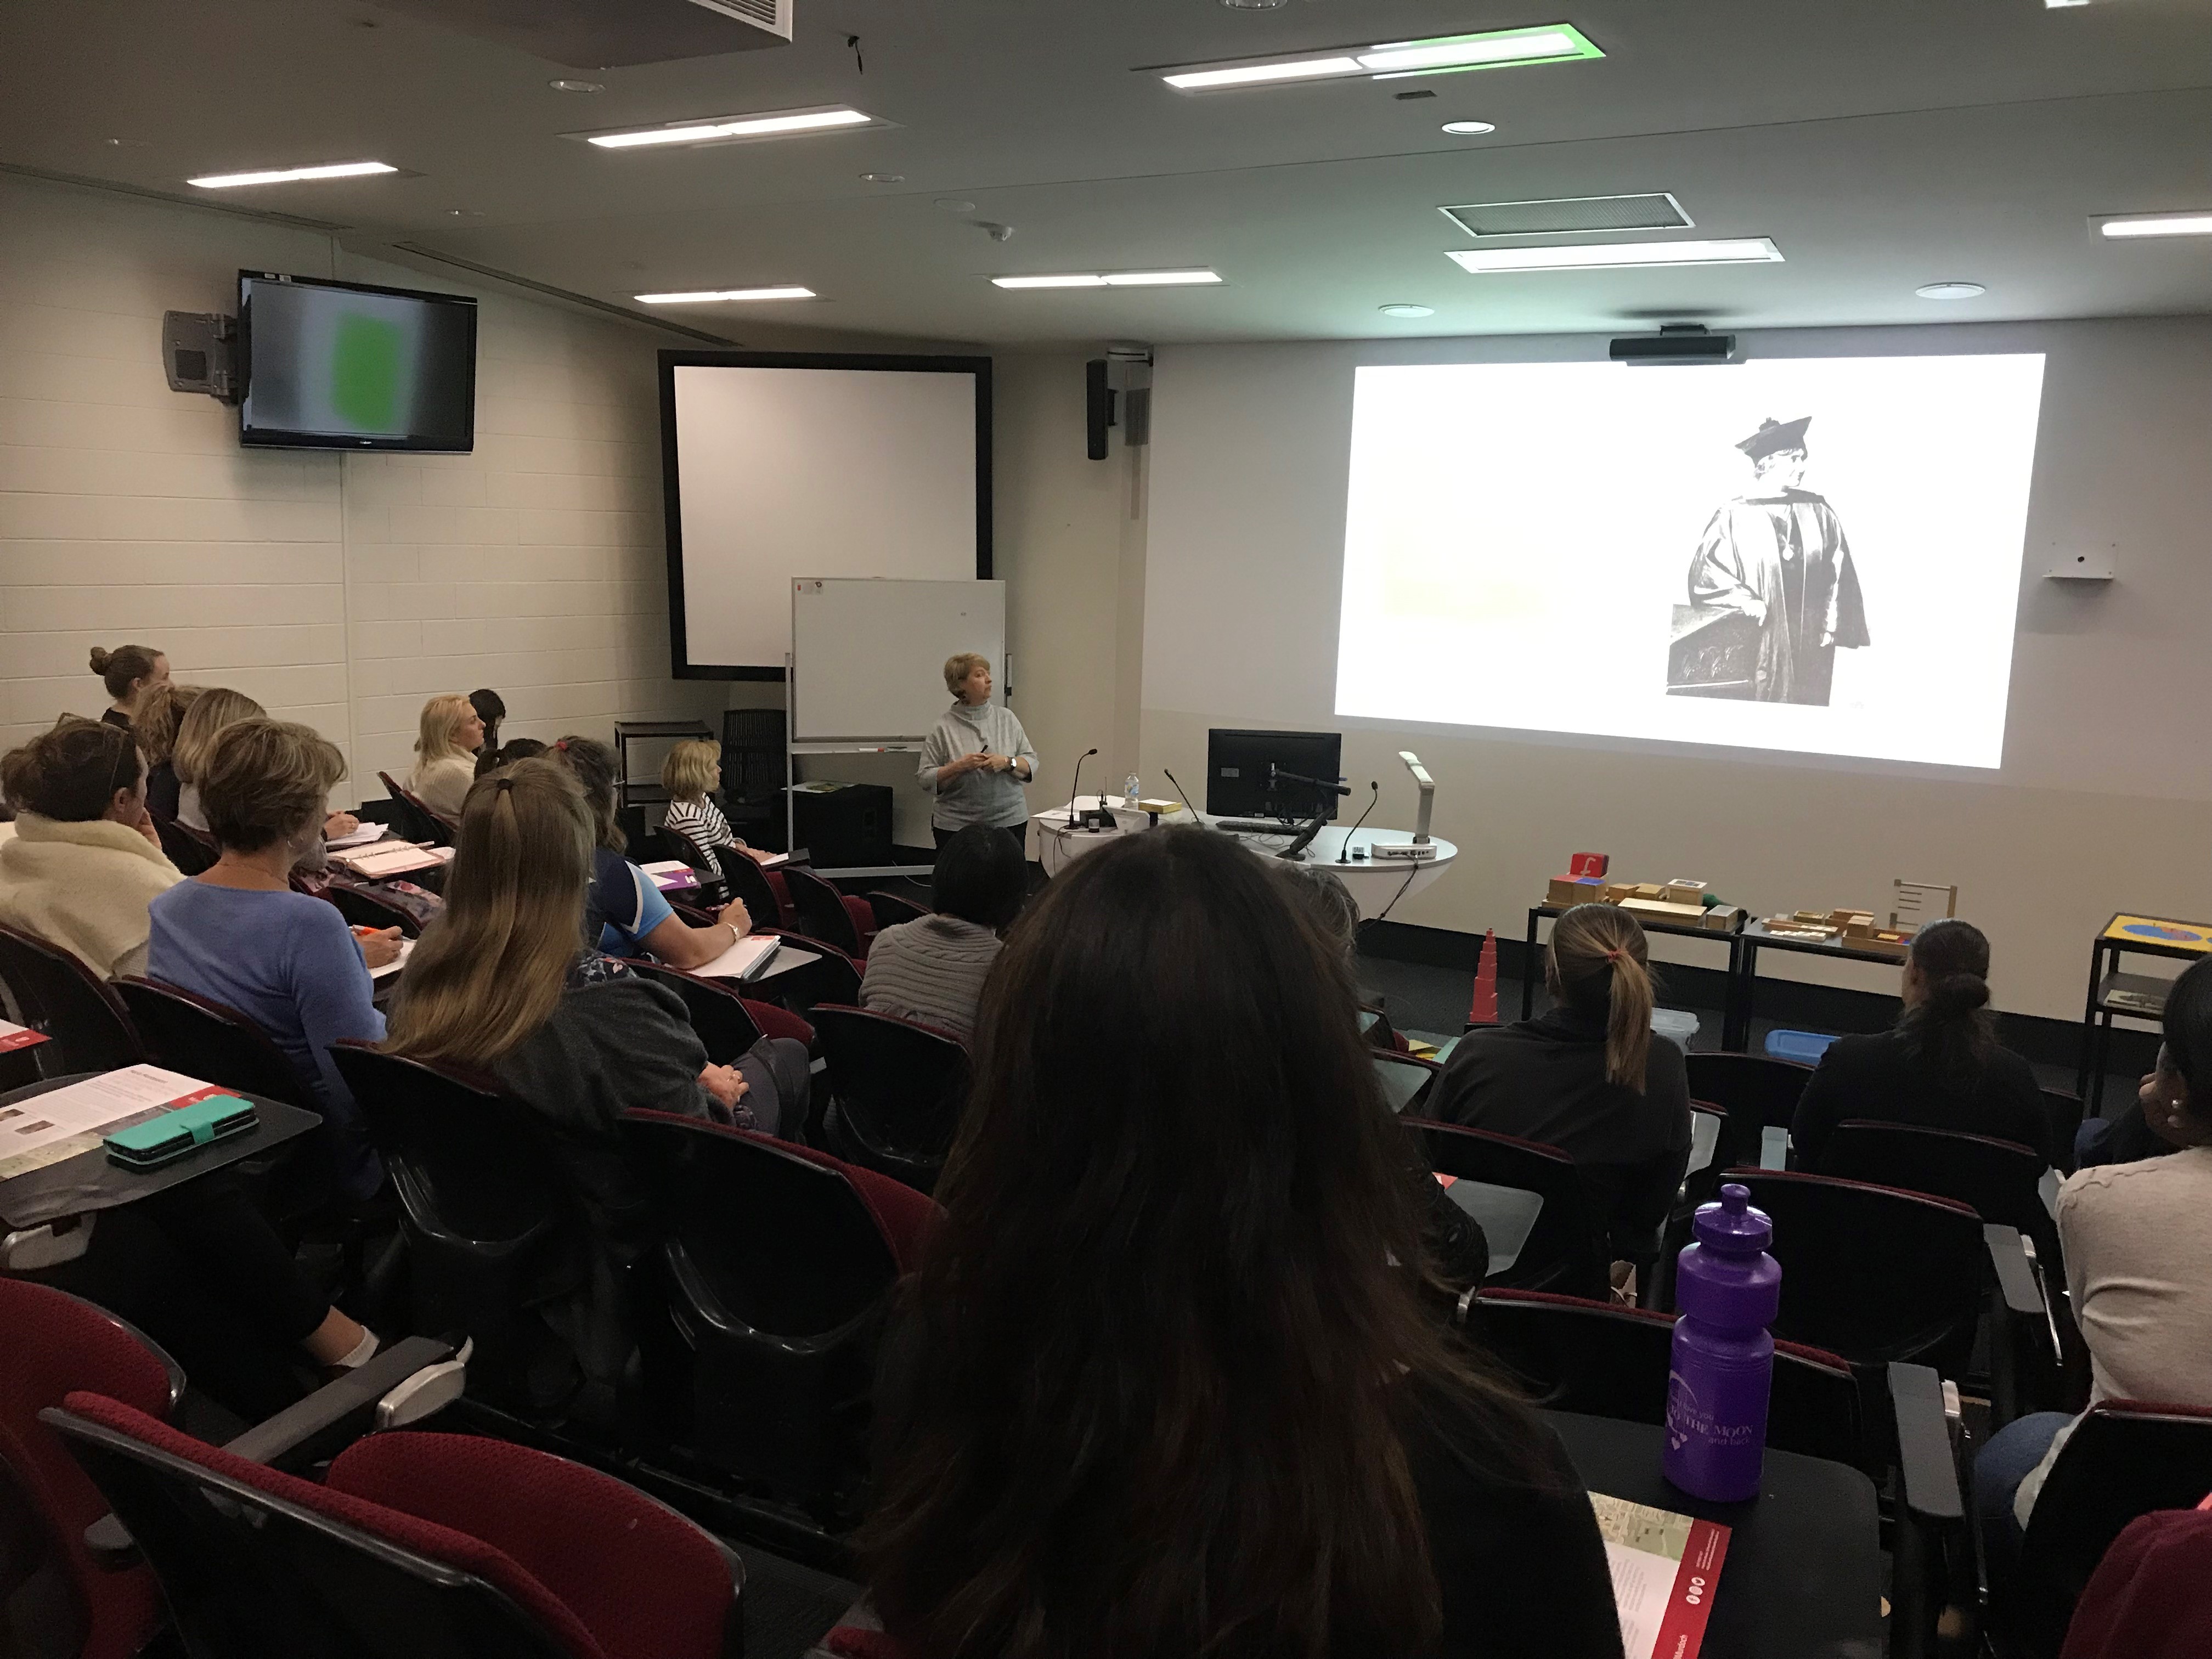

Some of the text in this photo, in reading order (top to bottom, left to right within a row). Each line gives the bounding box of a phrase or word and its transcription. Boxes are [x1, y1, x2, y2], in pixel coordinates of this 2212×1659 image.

[1699, 1412, 1714, 1420] you
[1686, 1415, 1709, 1435] THE
[1714, 1424, 1753, 1438] MOON
[1708, 1436, 1751, 1446] and back
